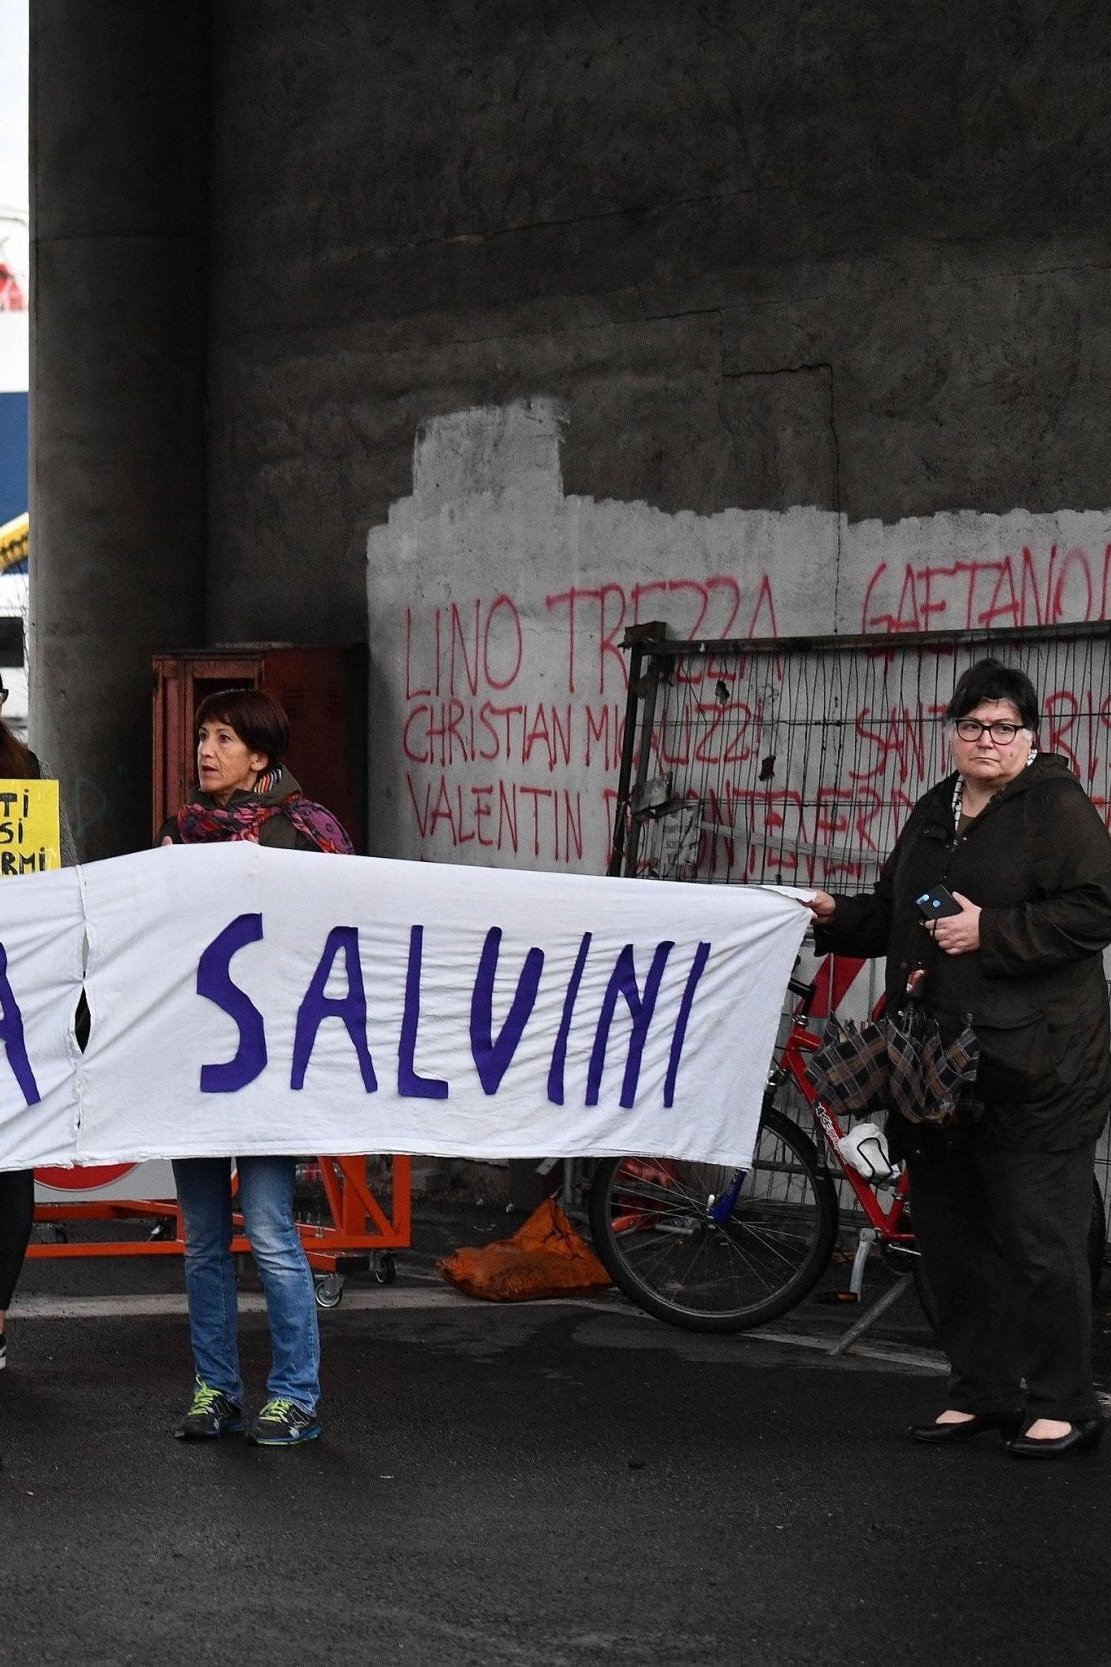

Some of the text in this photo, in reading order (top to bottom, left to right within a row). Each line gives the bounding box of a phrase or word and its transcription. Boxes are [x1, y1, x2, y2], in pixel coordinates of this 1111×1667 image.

[405, 594, 522, 700] LINO
[862, 543, 1094, 668] GAETANO
[403, 698, 572, 772] CHRISTIAN
[849, 702, 951, 784] SANT
[406, 772, 583, 862] VALENTIN
[197, 912, 711, 1109] SALVINI
